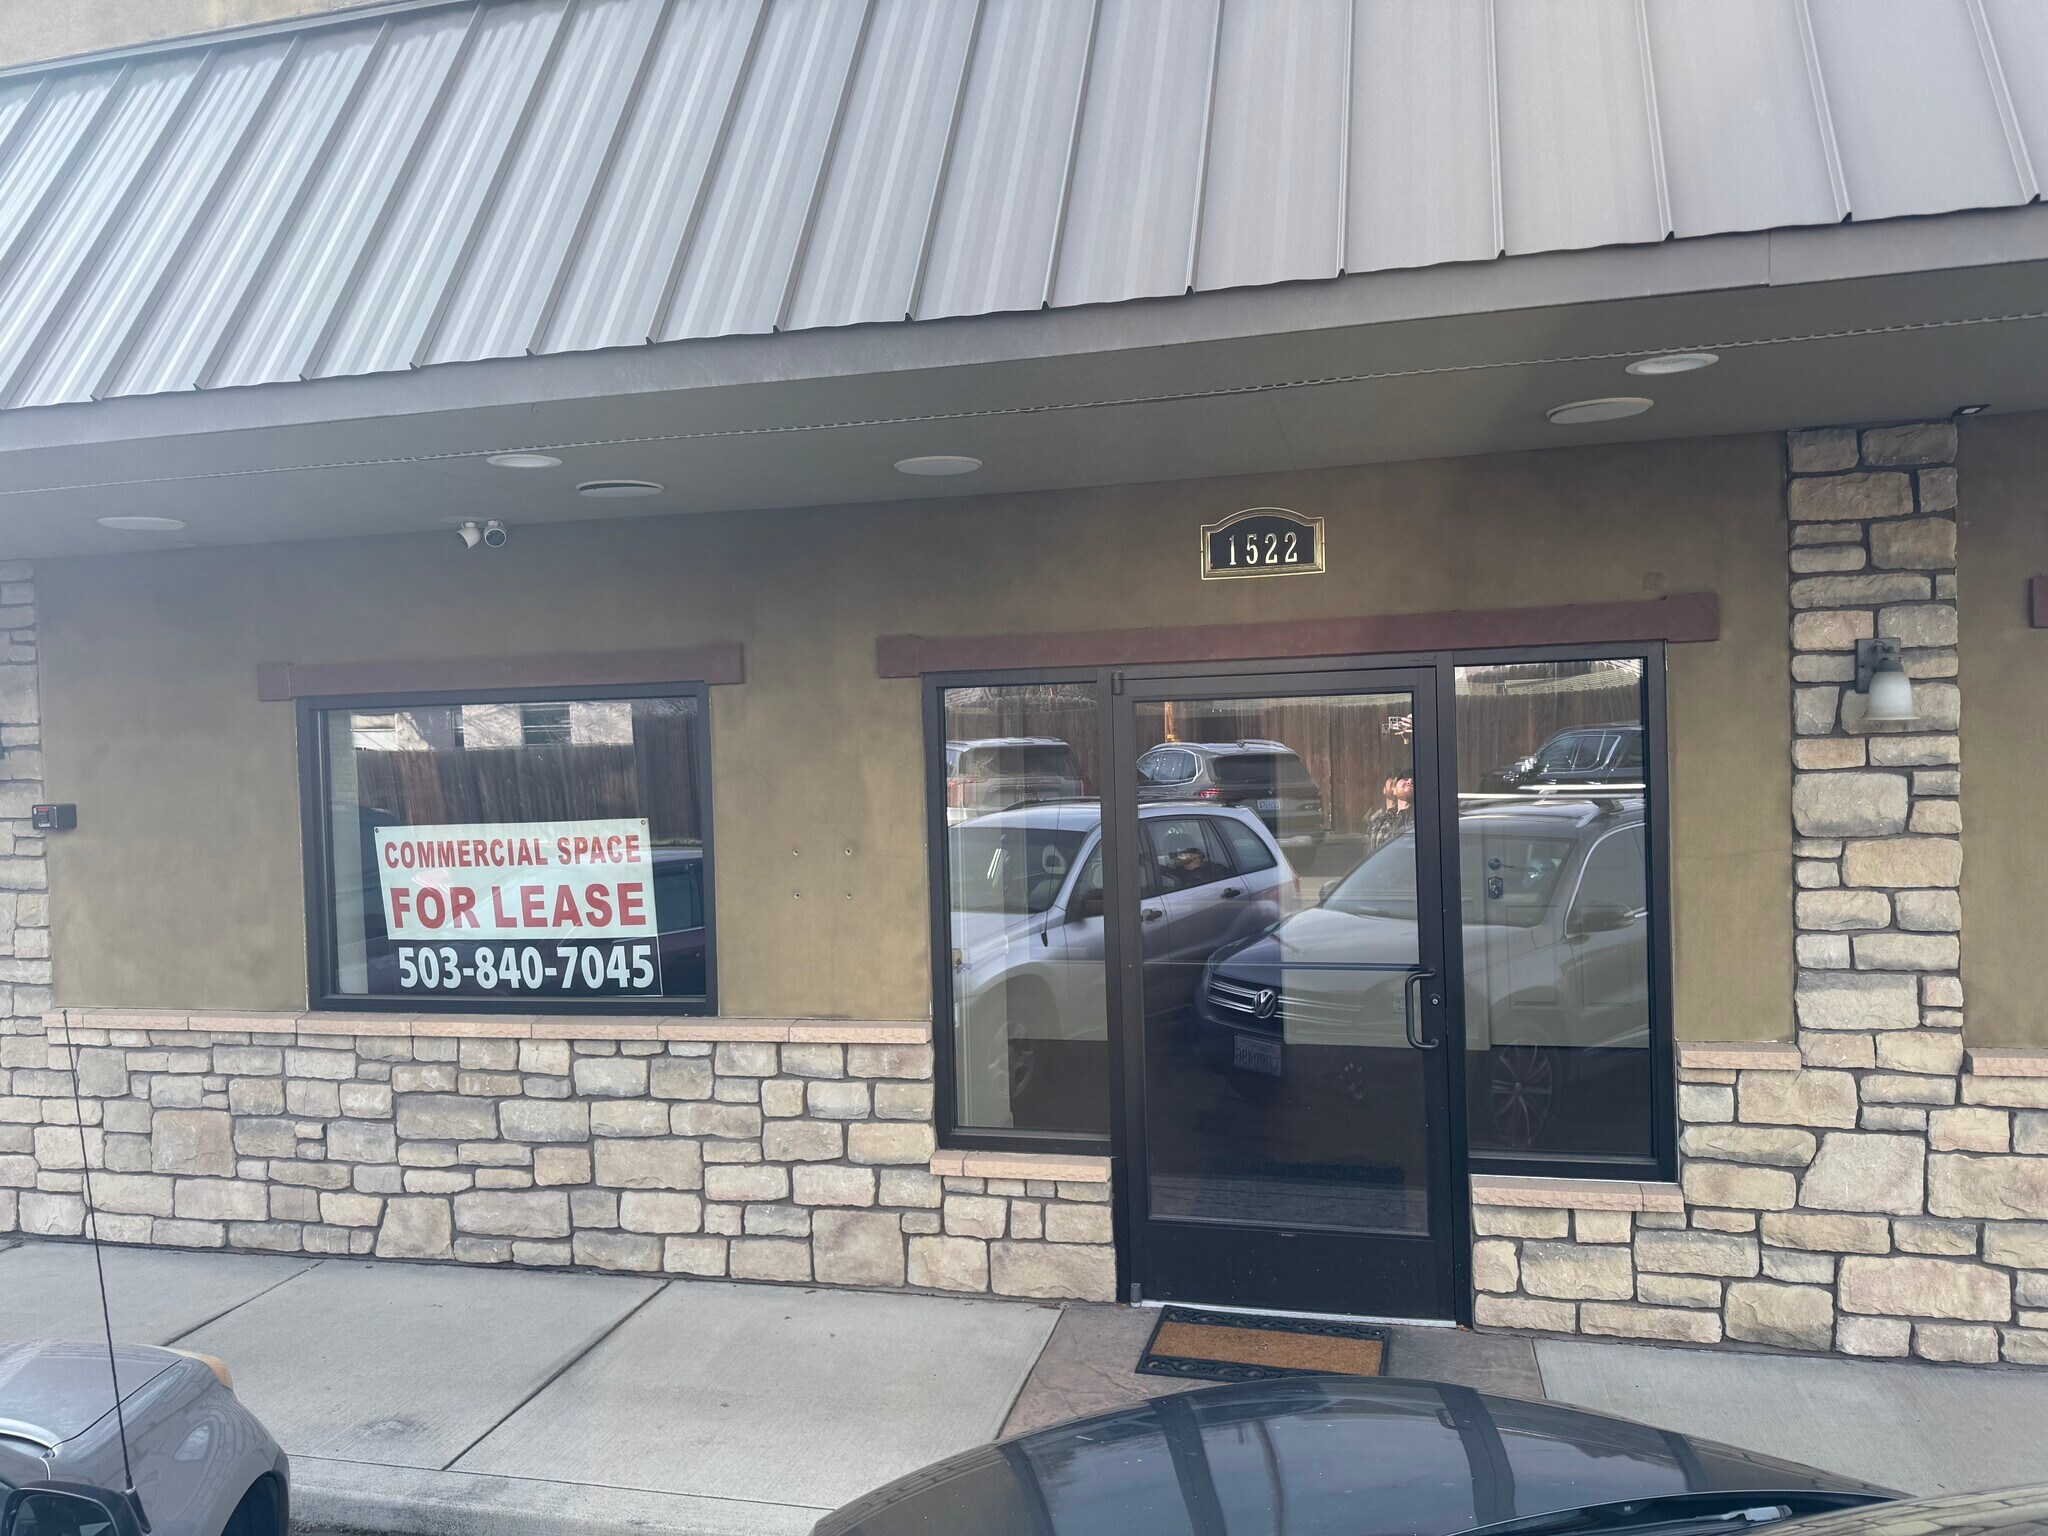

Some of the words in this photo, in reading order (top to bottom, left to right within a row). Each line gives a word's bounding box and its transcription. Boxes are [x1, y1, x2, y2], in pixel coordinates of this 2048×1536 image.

[1228, 531, 1298, 566] 1522
[384, 837, 548, 869] COMMERCIAL
[558, 834, 642, 865] SPACE
[389, 886, 480, 929] FOR
[491, 882, 647, 928] LEASE
[398, 944, 655, 990] 503-840-7045
